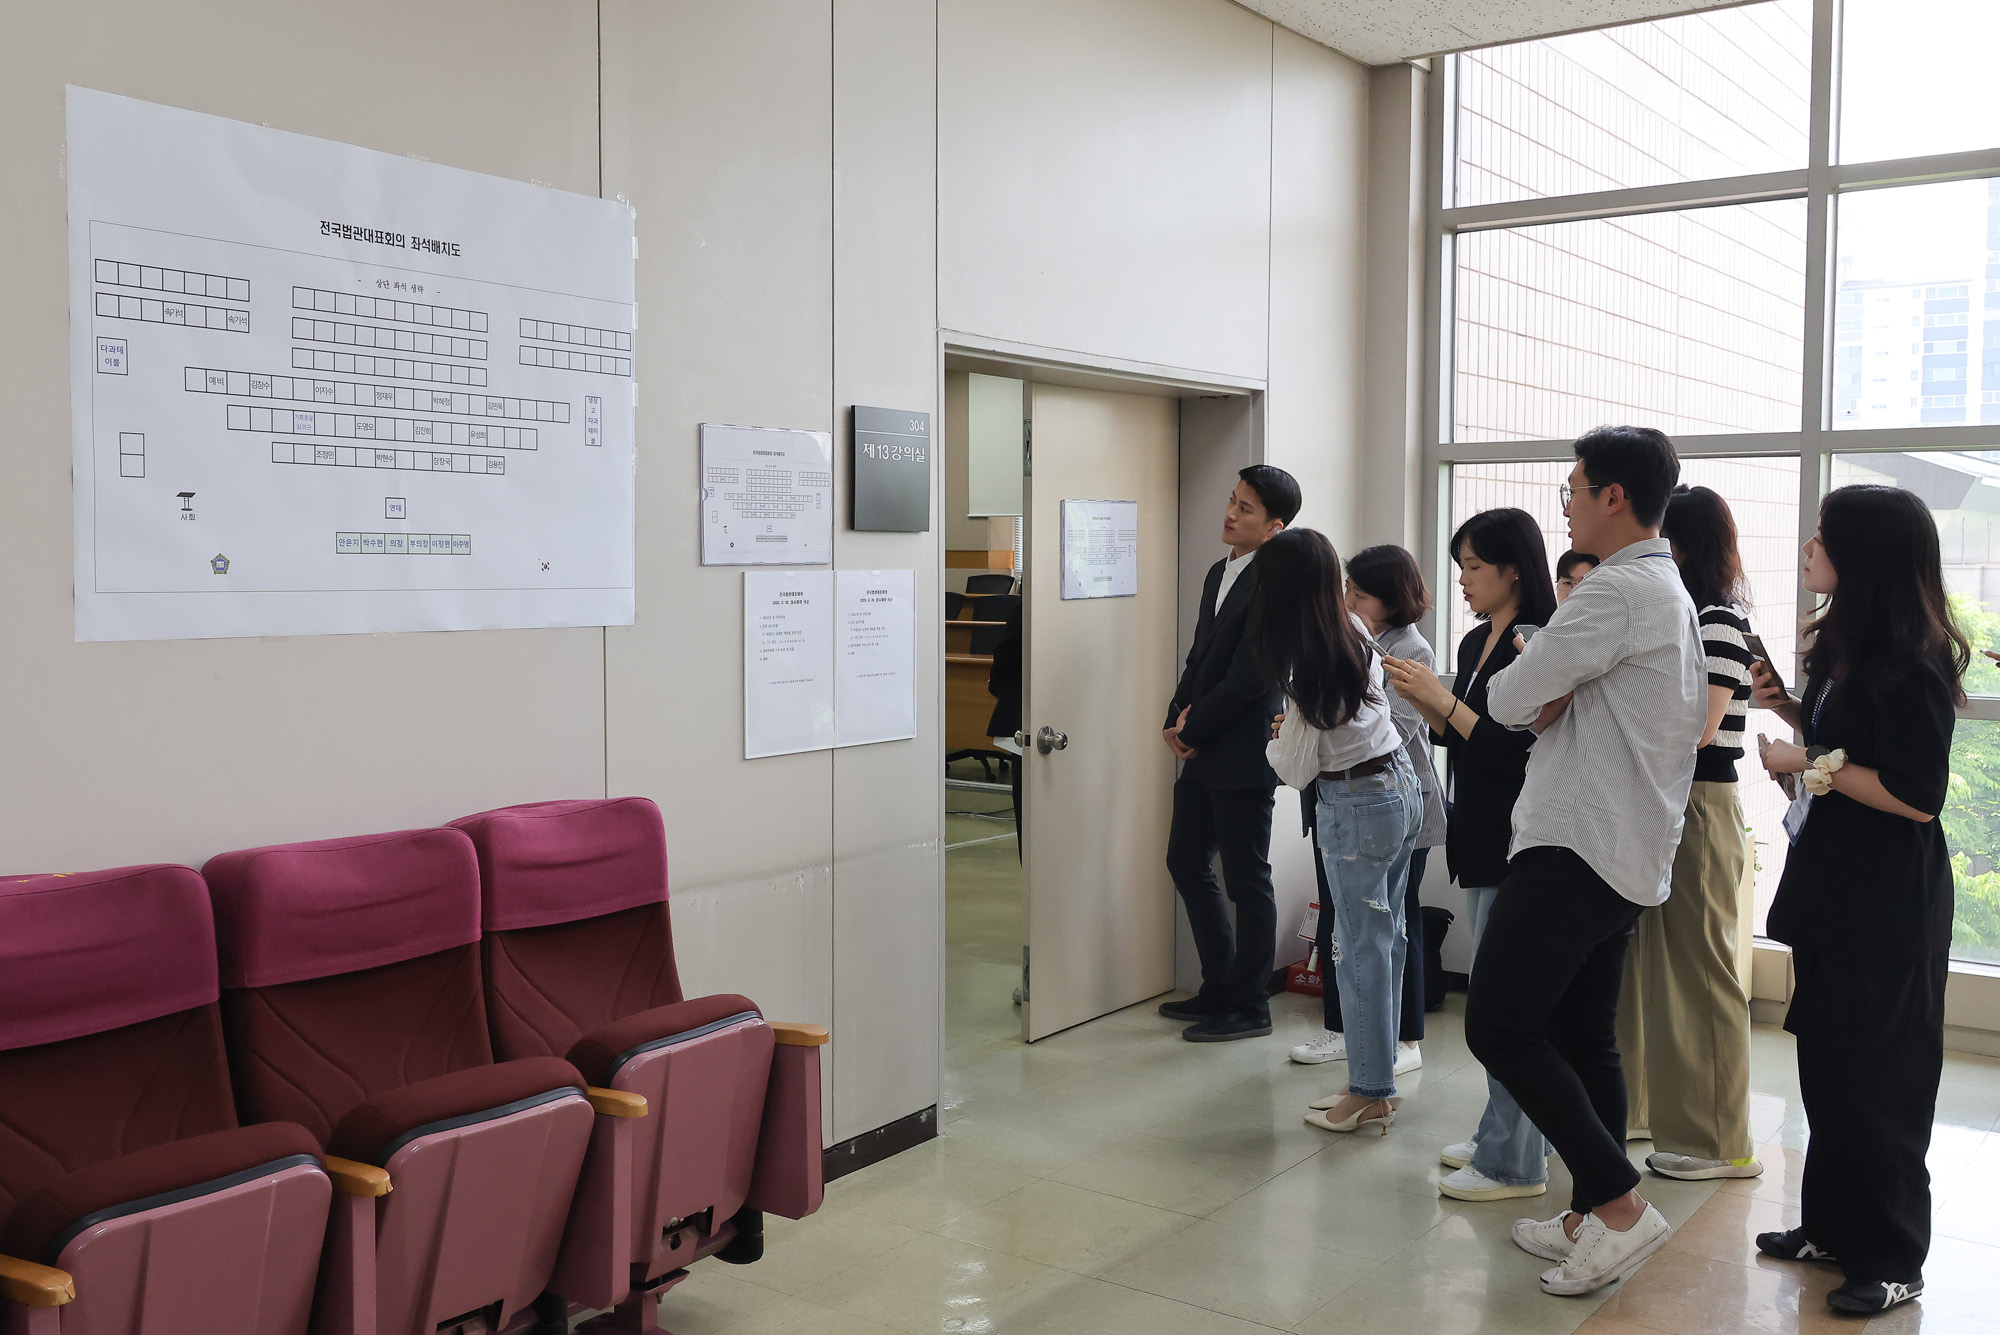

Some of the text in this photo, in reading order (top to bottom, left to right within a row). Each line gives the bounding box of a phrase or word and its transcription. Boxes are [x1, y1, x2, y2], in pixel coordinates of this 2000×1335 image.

[319, 220, 460, 256] 전국법관대표회의 좌석배치도
[375, 278, 424, 293] 상단 좌석 생략
[164, 307, 247, 325] 속기석 속기석
[100, 344, 123, 354] 다과테
[104, 358, 120, 367] 이블
[208, 376, 224, 386] 예비
[909, 419, 925, 432] 304
[862, 443, 925, 463] 제13강의실
[180, 513, 195, 521] 사회
[338, 538, 359, 547] 안은지
[362, 538, 382, 547] 박수현
[389, 539, 403, 547] 의장
[410, 539, 427, 547] 부의장
[1295, 973, 1320, 985] 소화
